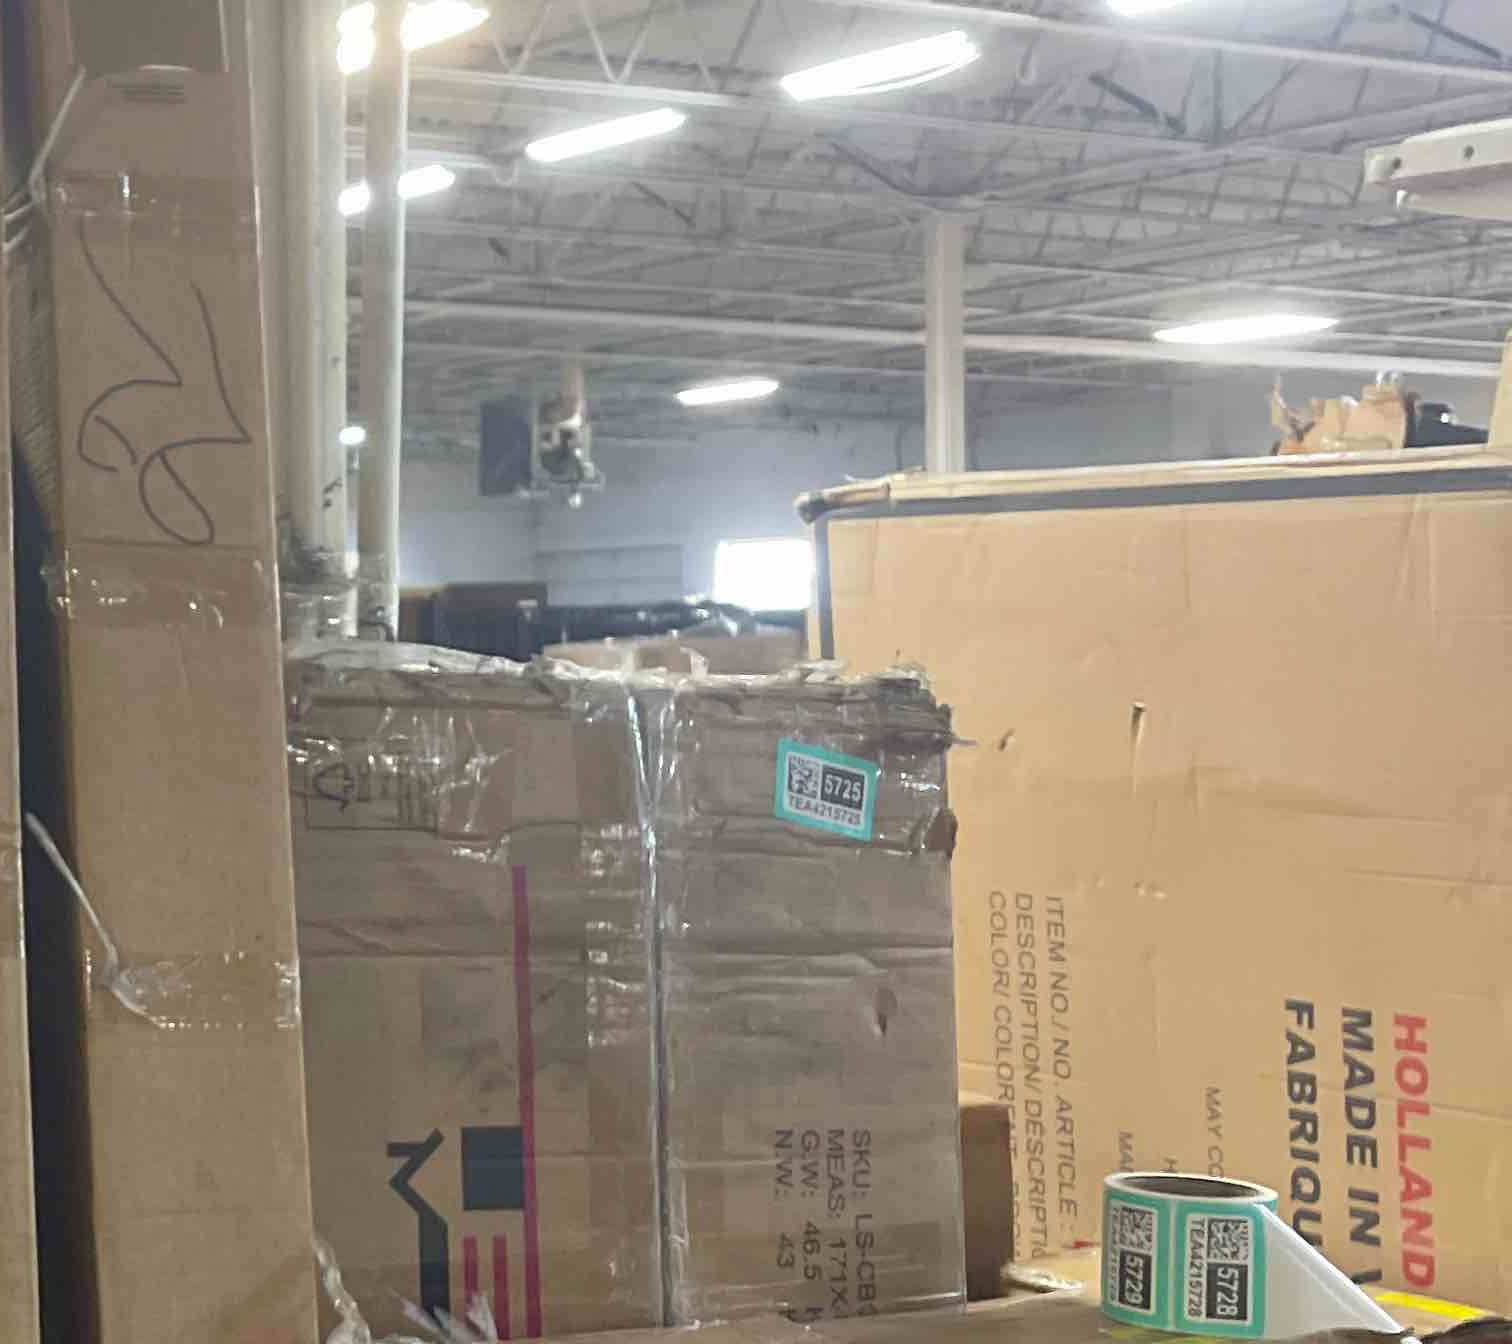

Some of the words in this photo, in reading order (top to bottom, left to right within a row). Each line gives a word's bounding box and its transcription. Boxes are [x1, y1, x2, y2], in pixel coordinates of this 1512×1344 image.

[824, 774, 861, 802] 5725
[1045, 895, 1068, 965] ITEM
[1015, 893, 1043, 1095] DESCRIPTION/
[993, 1004, 1018, 1160] COLOR
[1206, 1087, 1223, 1138] MAY
[1341, 1007, 1378, 1169] MADE
[827, 1129, 846, 1219] MEAS:
[852, 1129, 872, 1197] SKU:
[1055, 1095, 1077, 1218] ARTICLE
[1393, 1013, 1436, 1290] HOLLAND
[803, 1221, 822, 1281] 46.5
[1347, 1186, 1382, 1248] IN
[1124, 1256, 1145, 1307] 5729
[1187, 1218, 1206, 1318] TEA4215728
[1215, 1267, 1240, 1317] 5728
